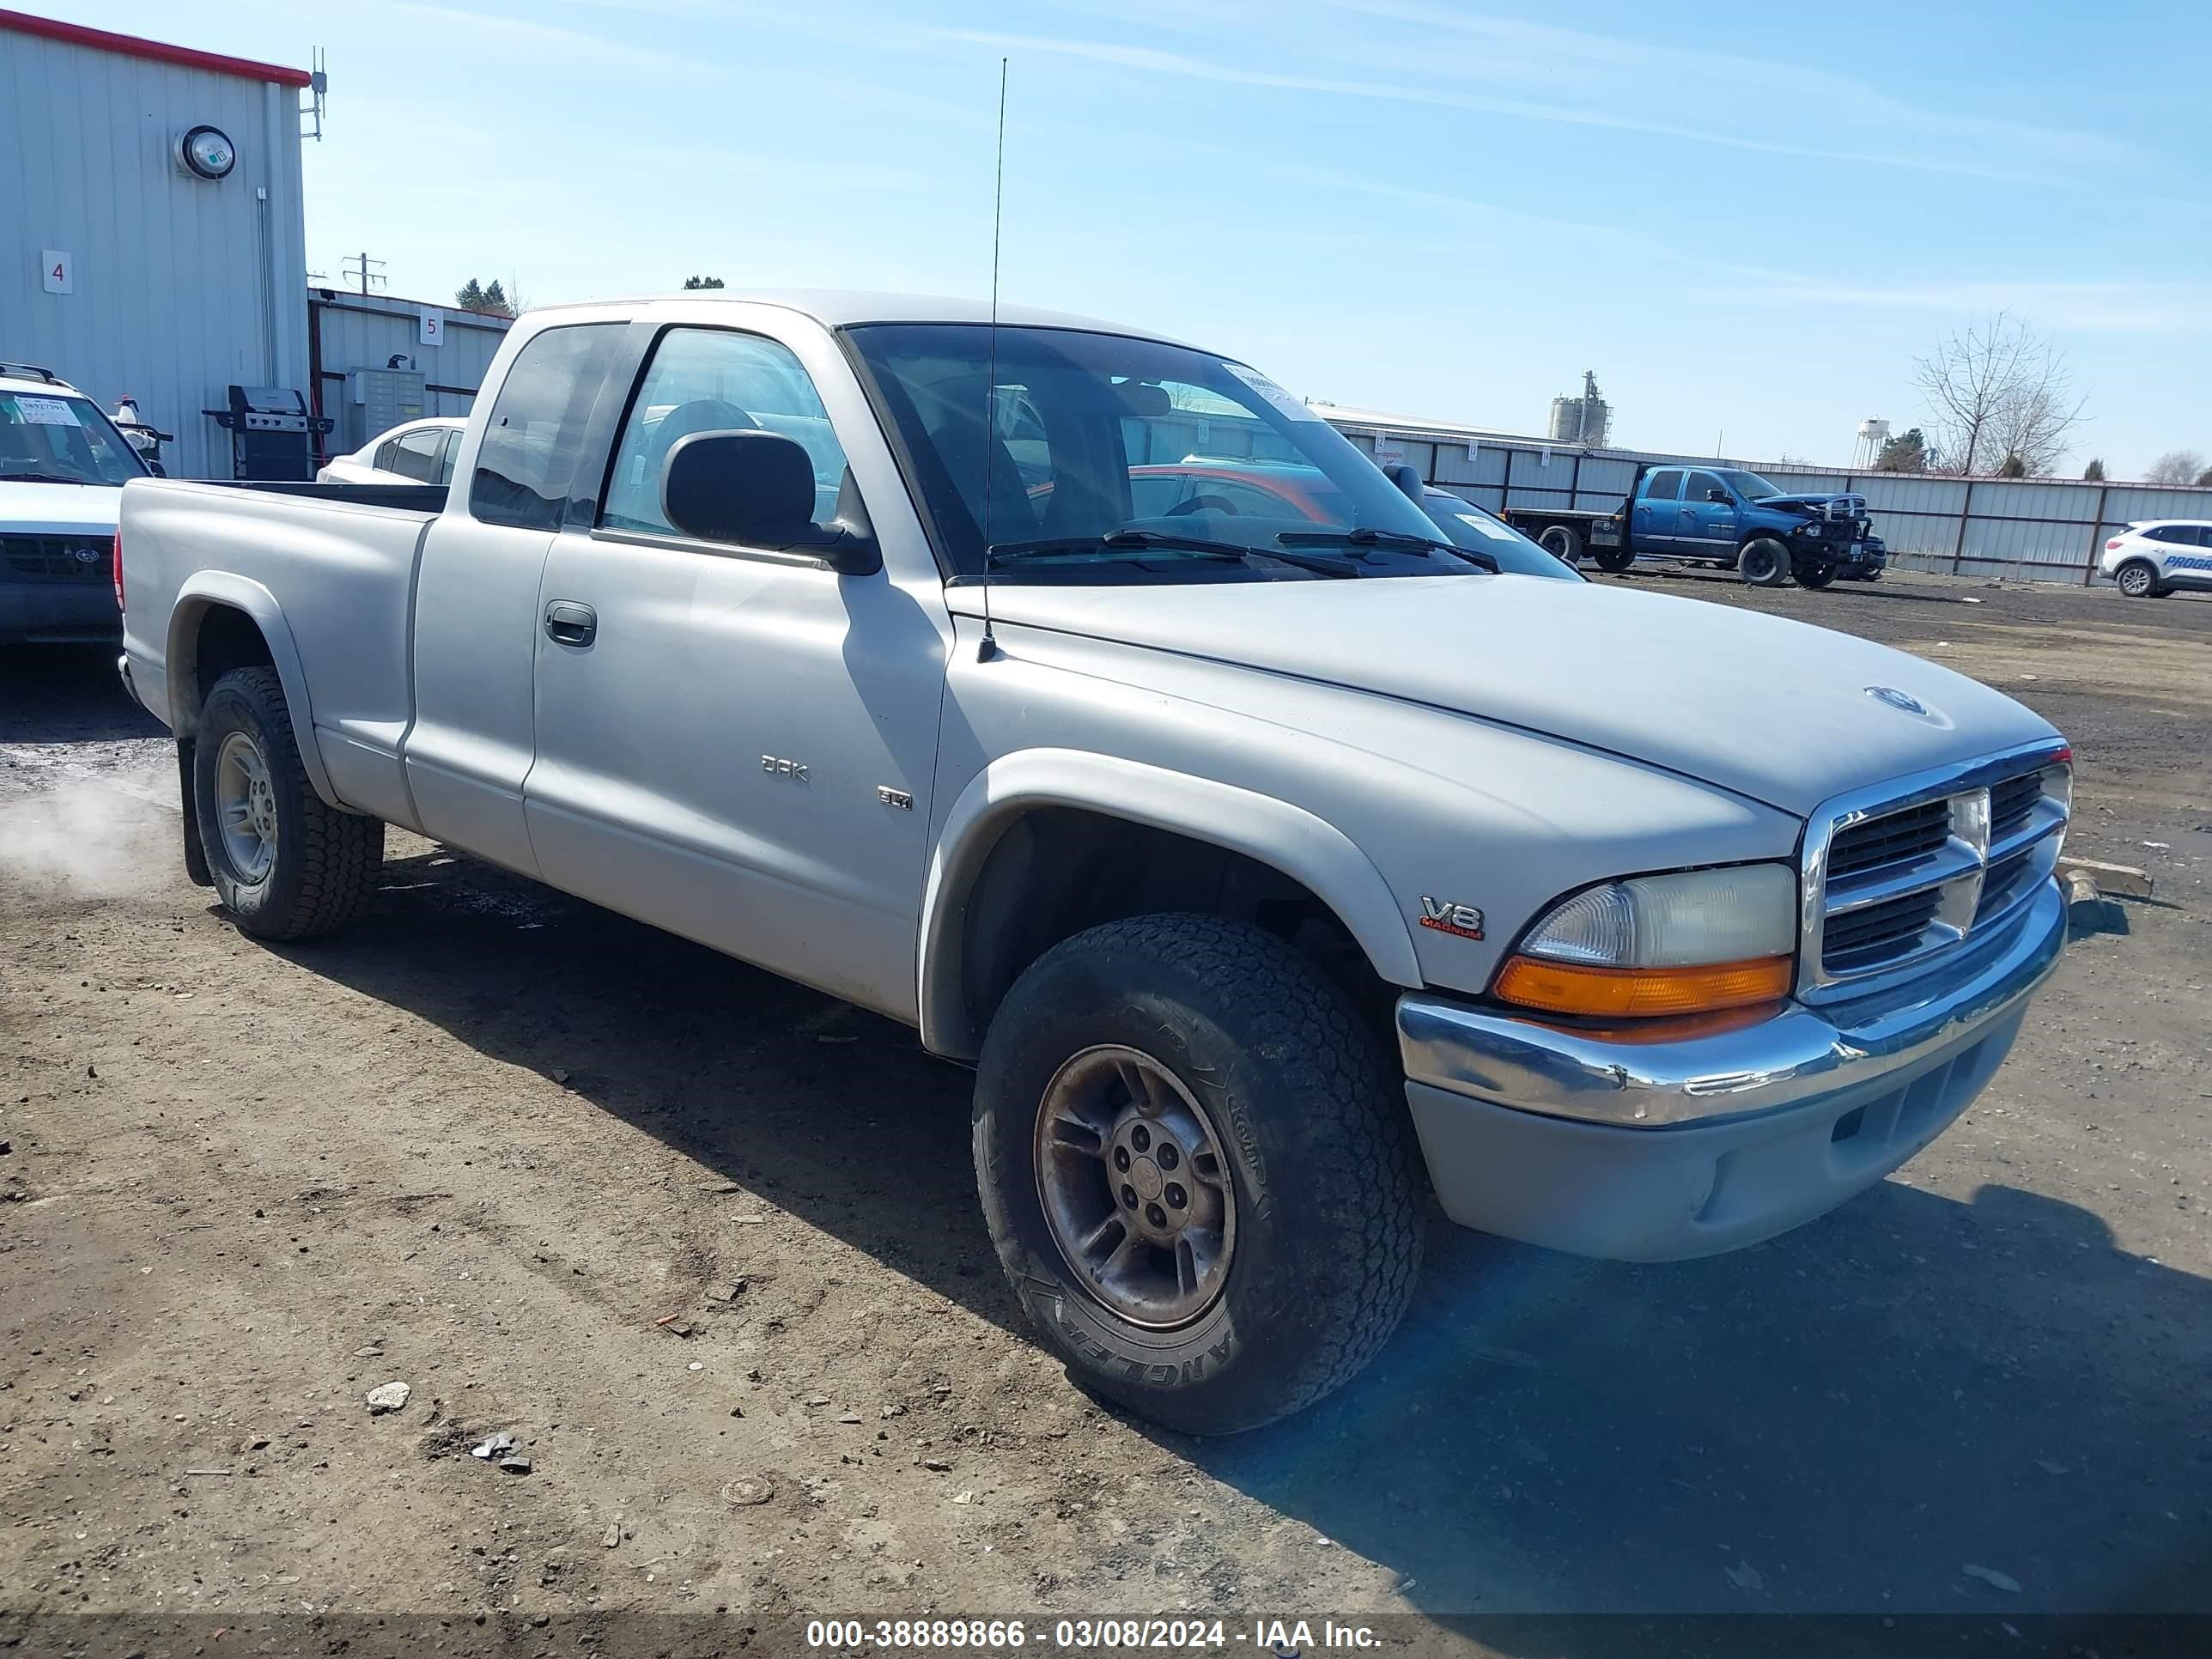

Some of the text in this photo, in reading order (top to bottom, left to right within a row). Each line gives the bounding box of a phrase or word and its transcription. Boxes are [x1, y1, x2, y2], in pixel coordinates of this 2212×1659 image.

[52, 263, 64, 282] 4
[427, 318, 436, 335] 5
[1376, 436, 1383, 447] 12
[1420, 896, 1481, 931] V8
[1420, 916, 1481, 939] MAGNUM
